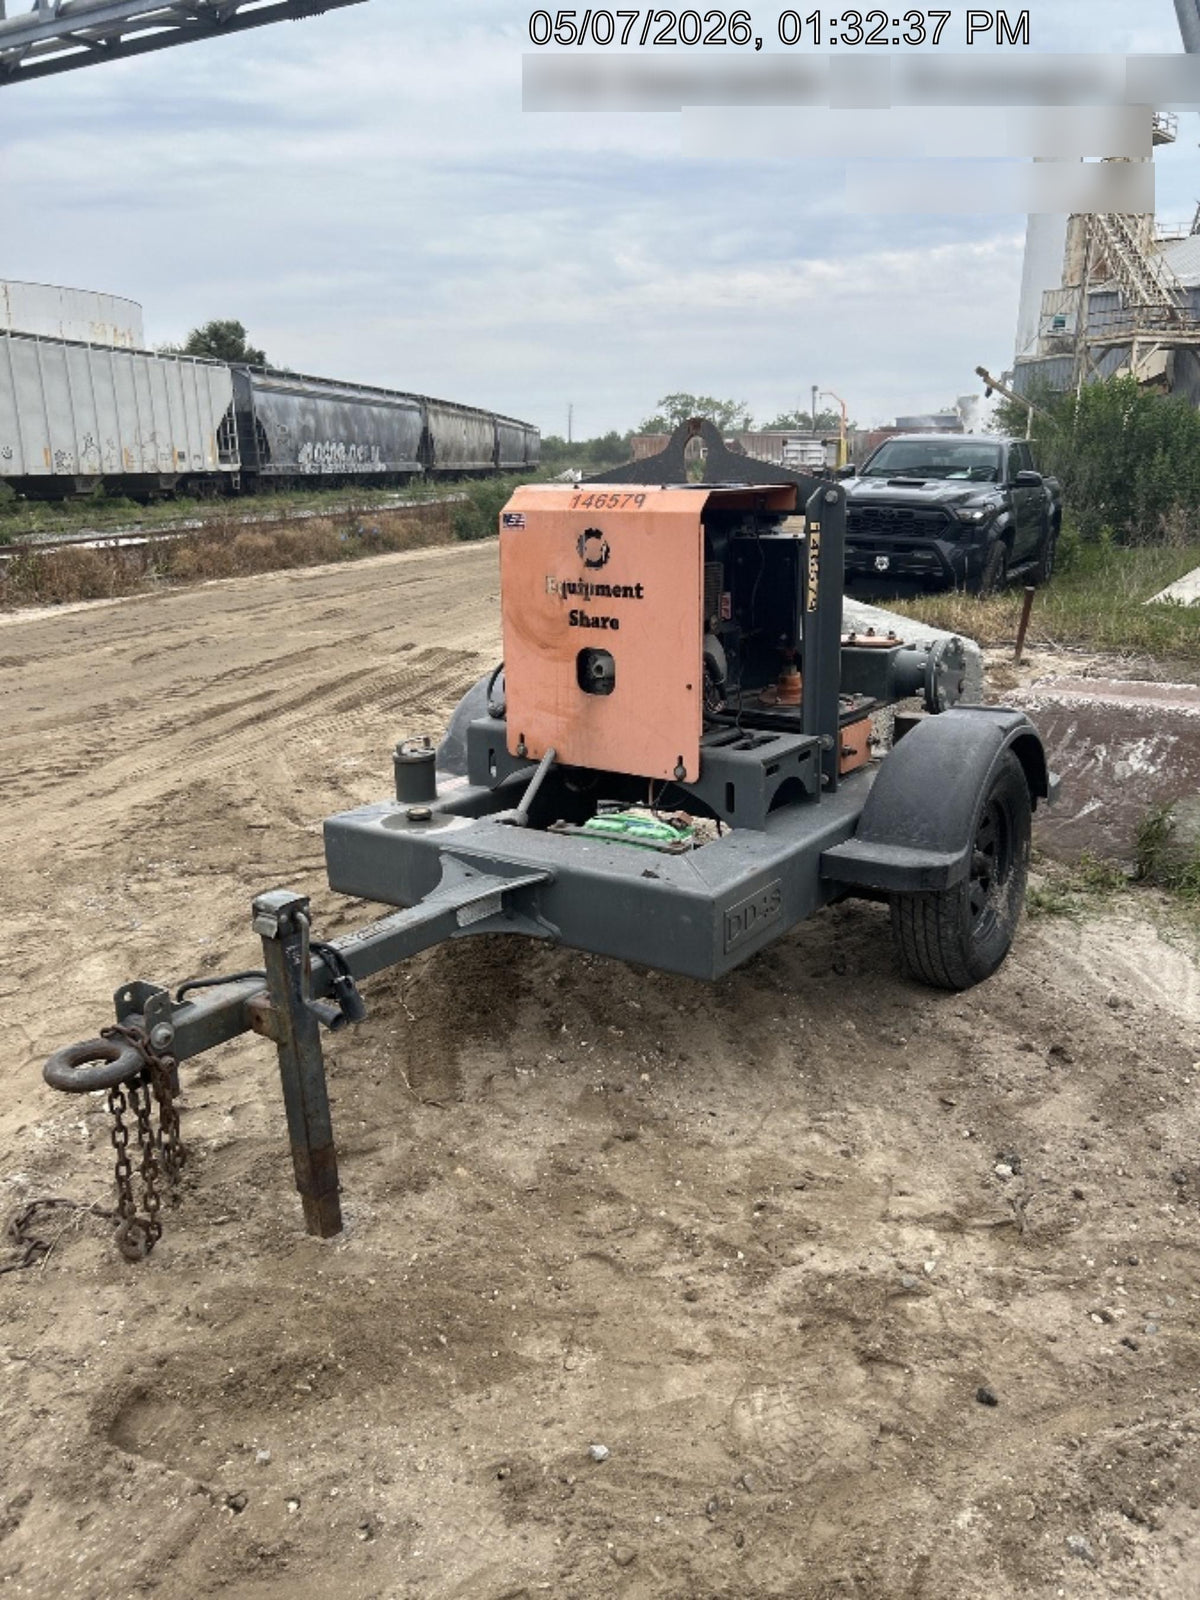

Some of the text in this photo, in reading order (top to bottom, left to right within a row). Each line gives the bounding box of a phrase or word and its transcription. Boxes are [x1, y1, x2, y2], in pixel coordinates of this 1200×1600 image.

[572, 493, 647, 509] 146579
[546, 576, 644, 601] Equipment
[569, 609, 619, 630] Share
